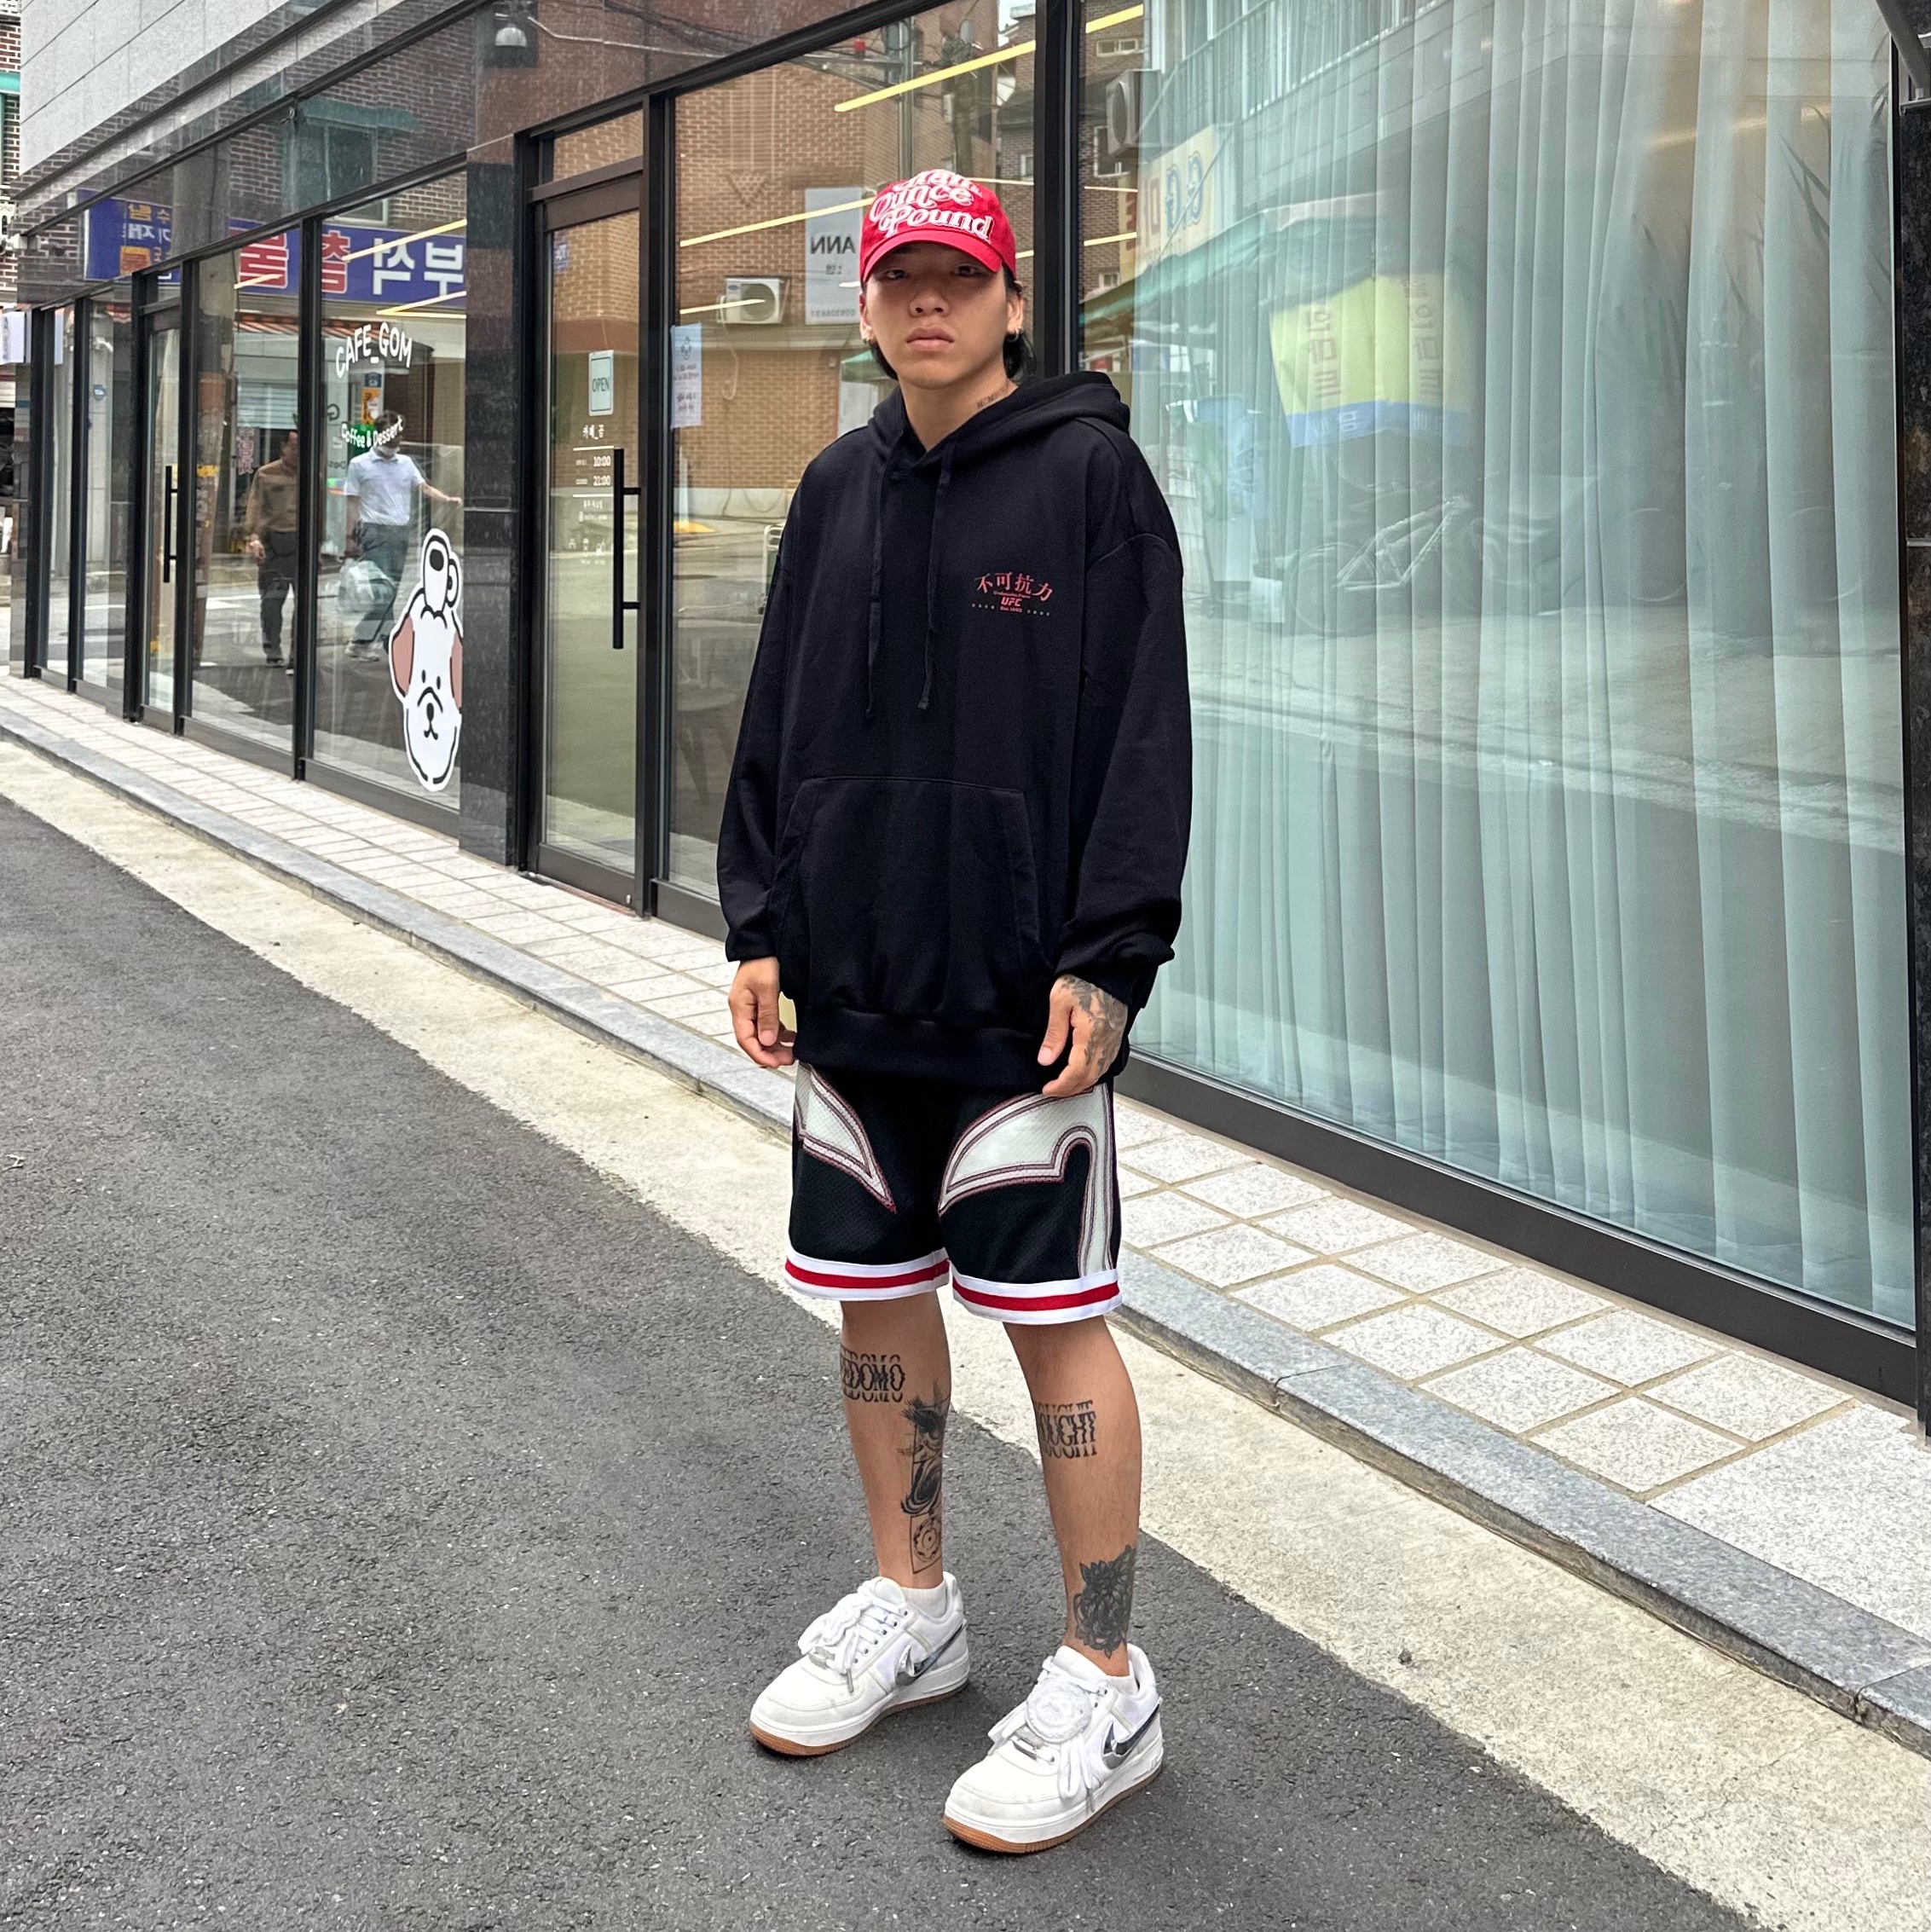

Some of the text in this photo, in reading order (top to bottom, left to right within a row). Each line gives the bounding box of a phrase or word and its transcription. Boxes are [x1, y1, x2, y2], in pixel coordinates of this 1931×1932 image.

[869, 183, 974, 223] Ounce
[878, 205, 995, 244] Pound
[592, 376, 610, 393] OPEN
[341, 423, 366, 448] Coffee
[373, 414, 404, 447] Dessert
[593, 455, 611, 467] 10:00
[593, 475, 611, 487] 21:00
[974, 571, 1054, 602] 不可抗力
[1000, 597, 1023, 607] UFC
